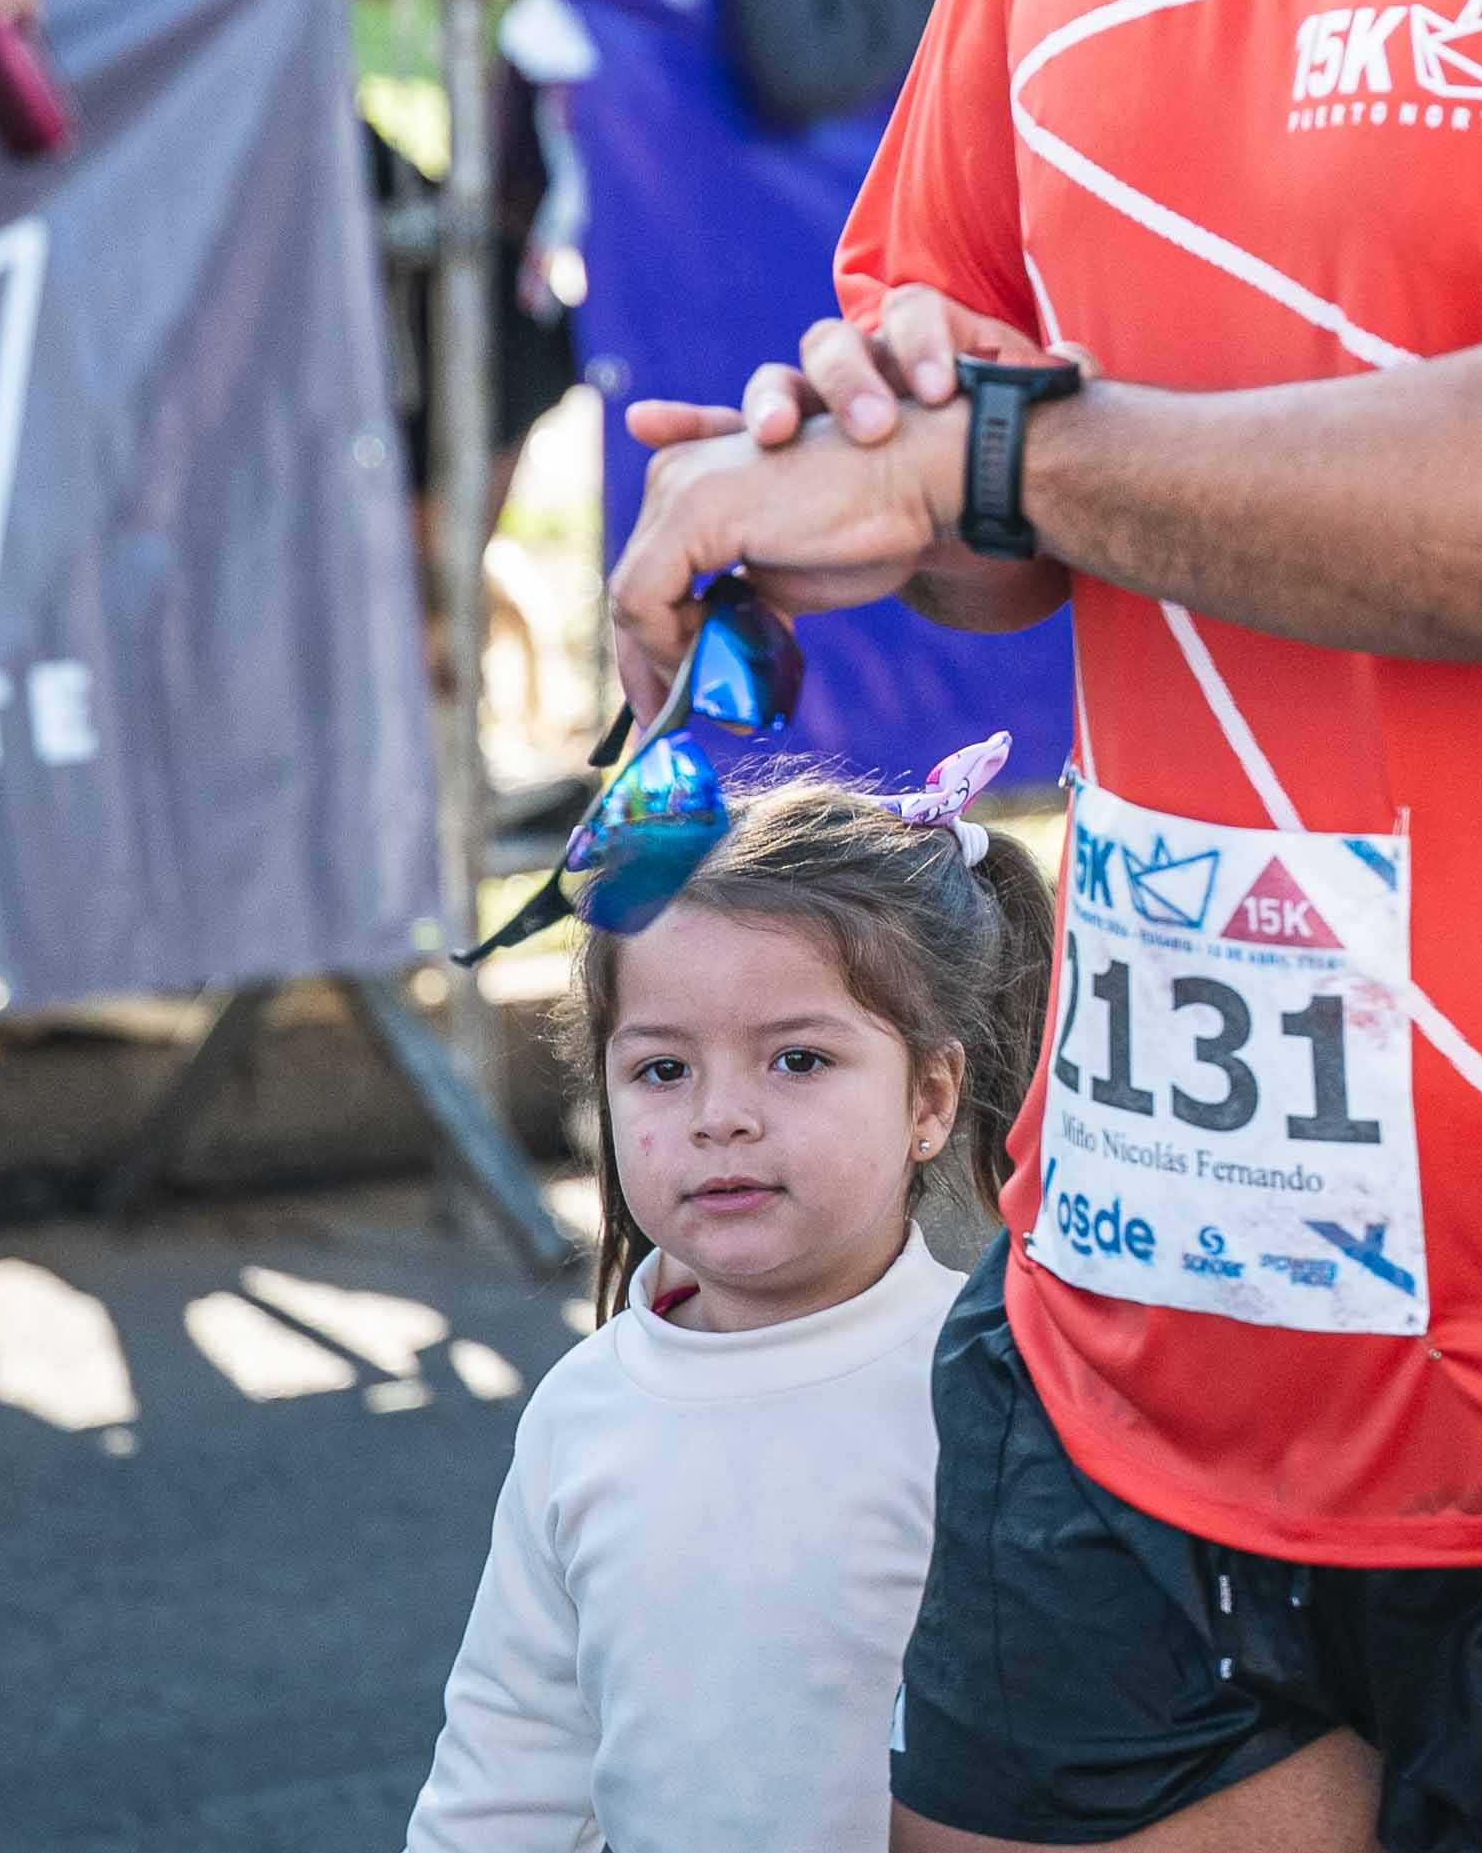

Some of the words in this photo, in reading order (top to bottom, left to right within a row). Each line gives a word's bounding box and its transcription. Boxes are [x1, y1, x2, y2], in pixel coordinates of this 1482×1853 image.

[1291, 5, 1409, 102] 15K
[1286, 100, 1389, 135] PUERTO
[1243, 895, 1314, 939] 15K
[1102, 1127, 1189, 1175] Nicolás
[1196, 1149, 1325, 1194] Fernando
[1057, 1192, 1156, 1262] osde
